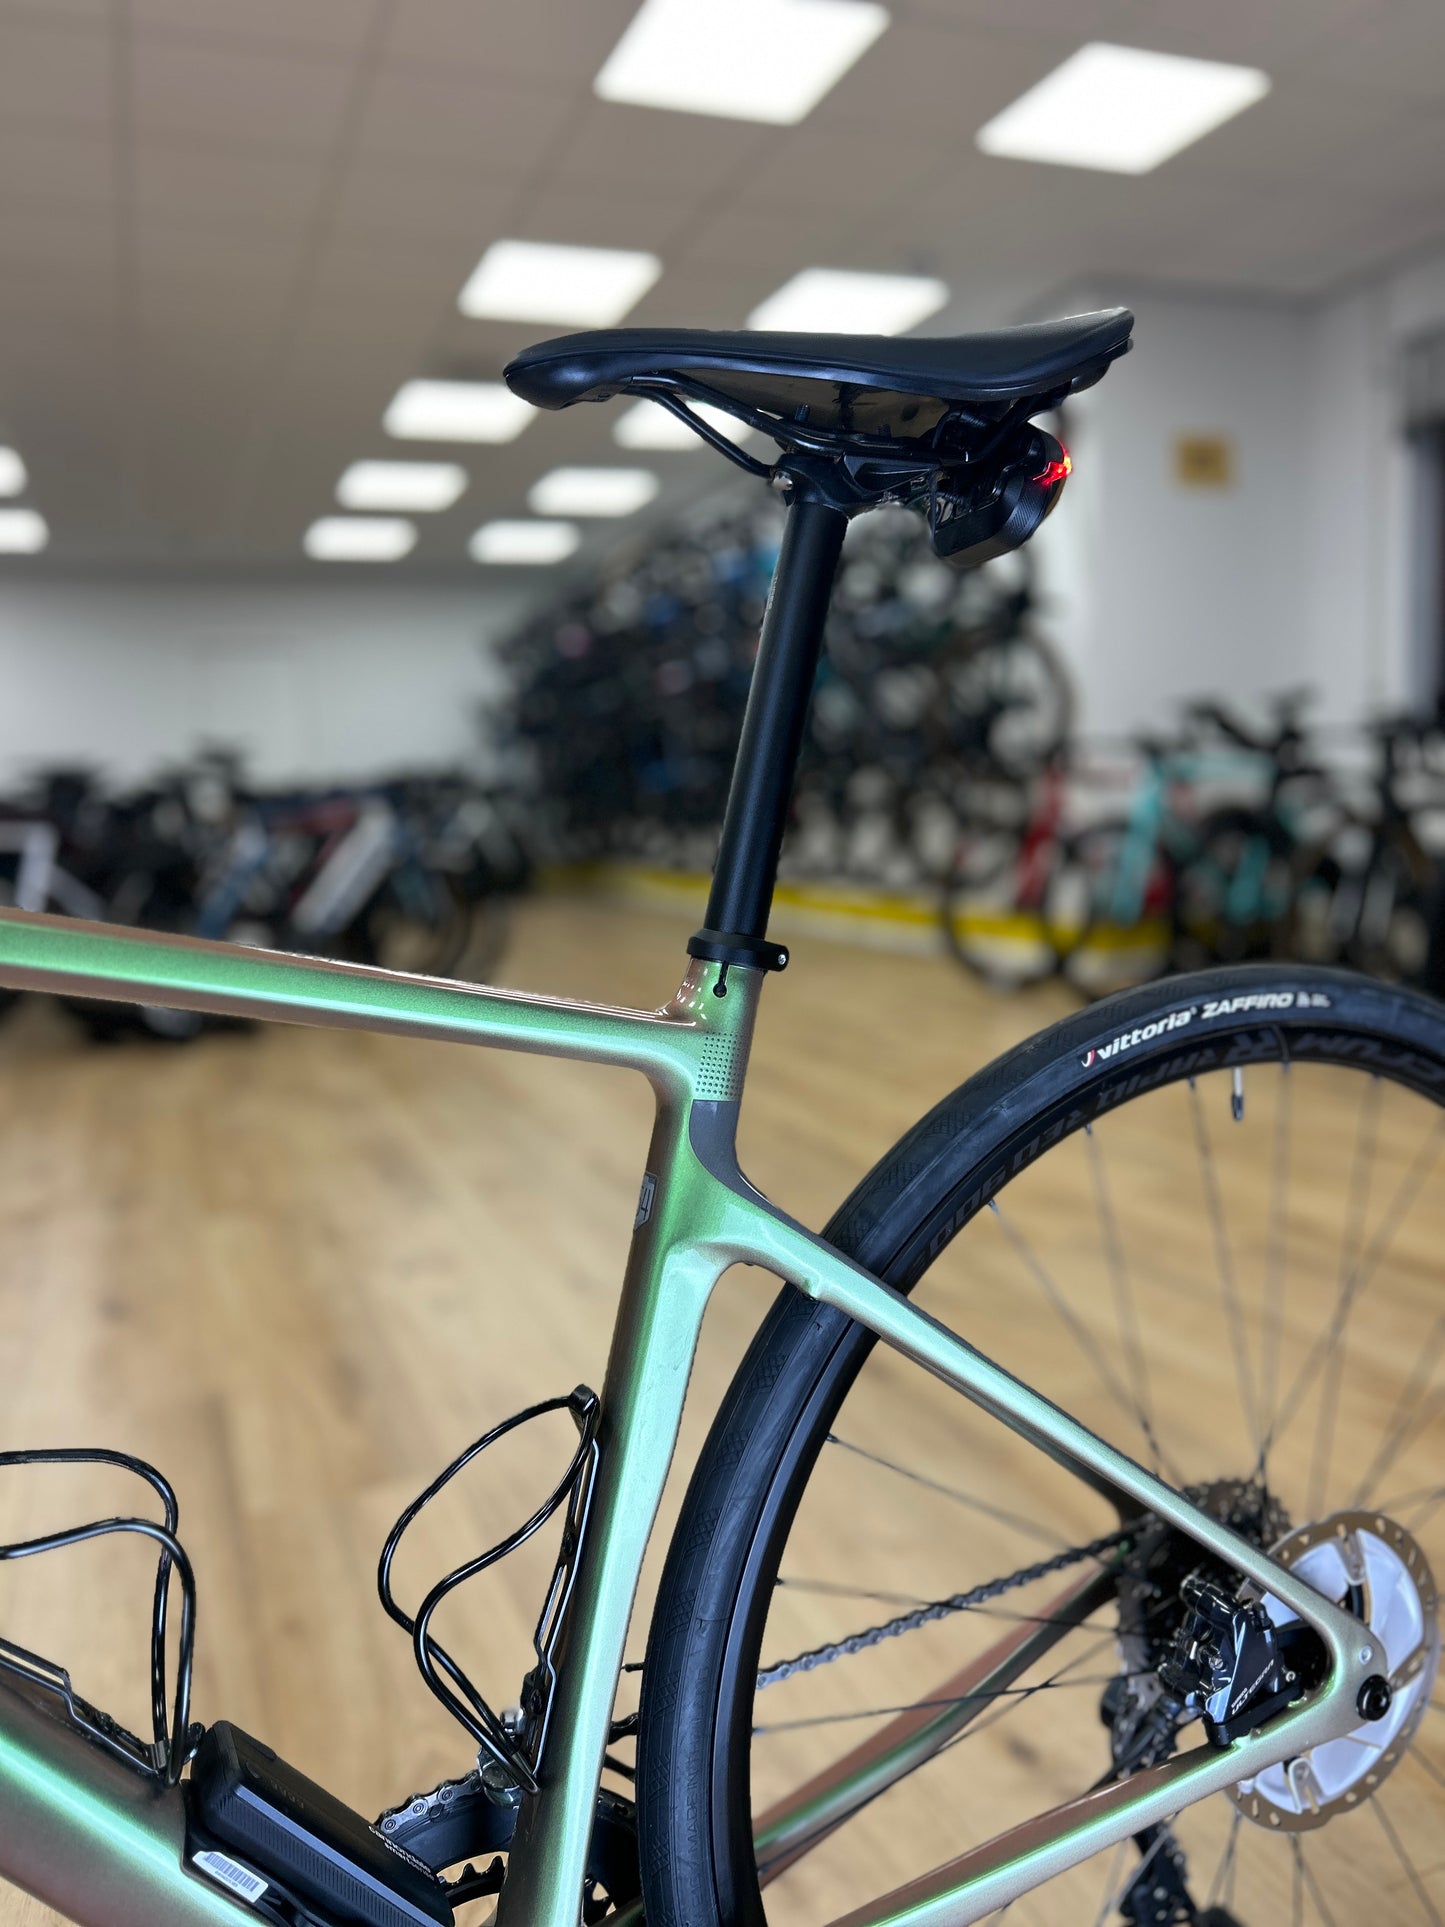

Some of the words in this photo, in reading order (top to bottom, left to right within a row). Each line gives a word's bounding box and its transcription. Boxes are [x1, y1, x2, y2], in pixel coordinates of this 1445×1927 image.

[1097, 1009, 1194, 1060] vittoria
[1201, 993, 1293, 1020] ZAFFIRO
[1231, 1659, 1274, 1715] ULTEGRA
